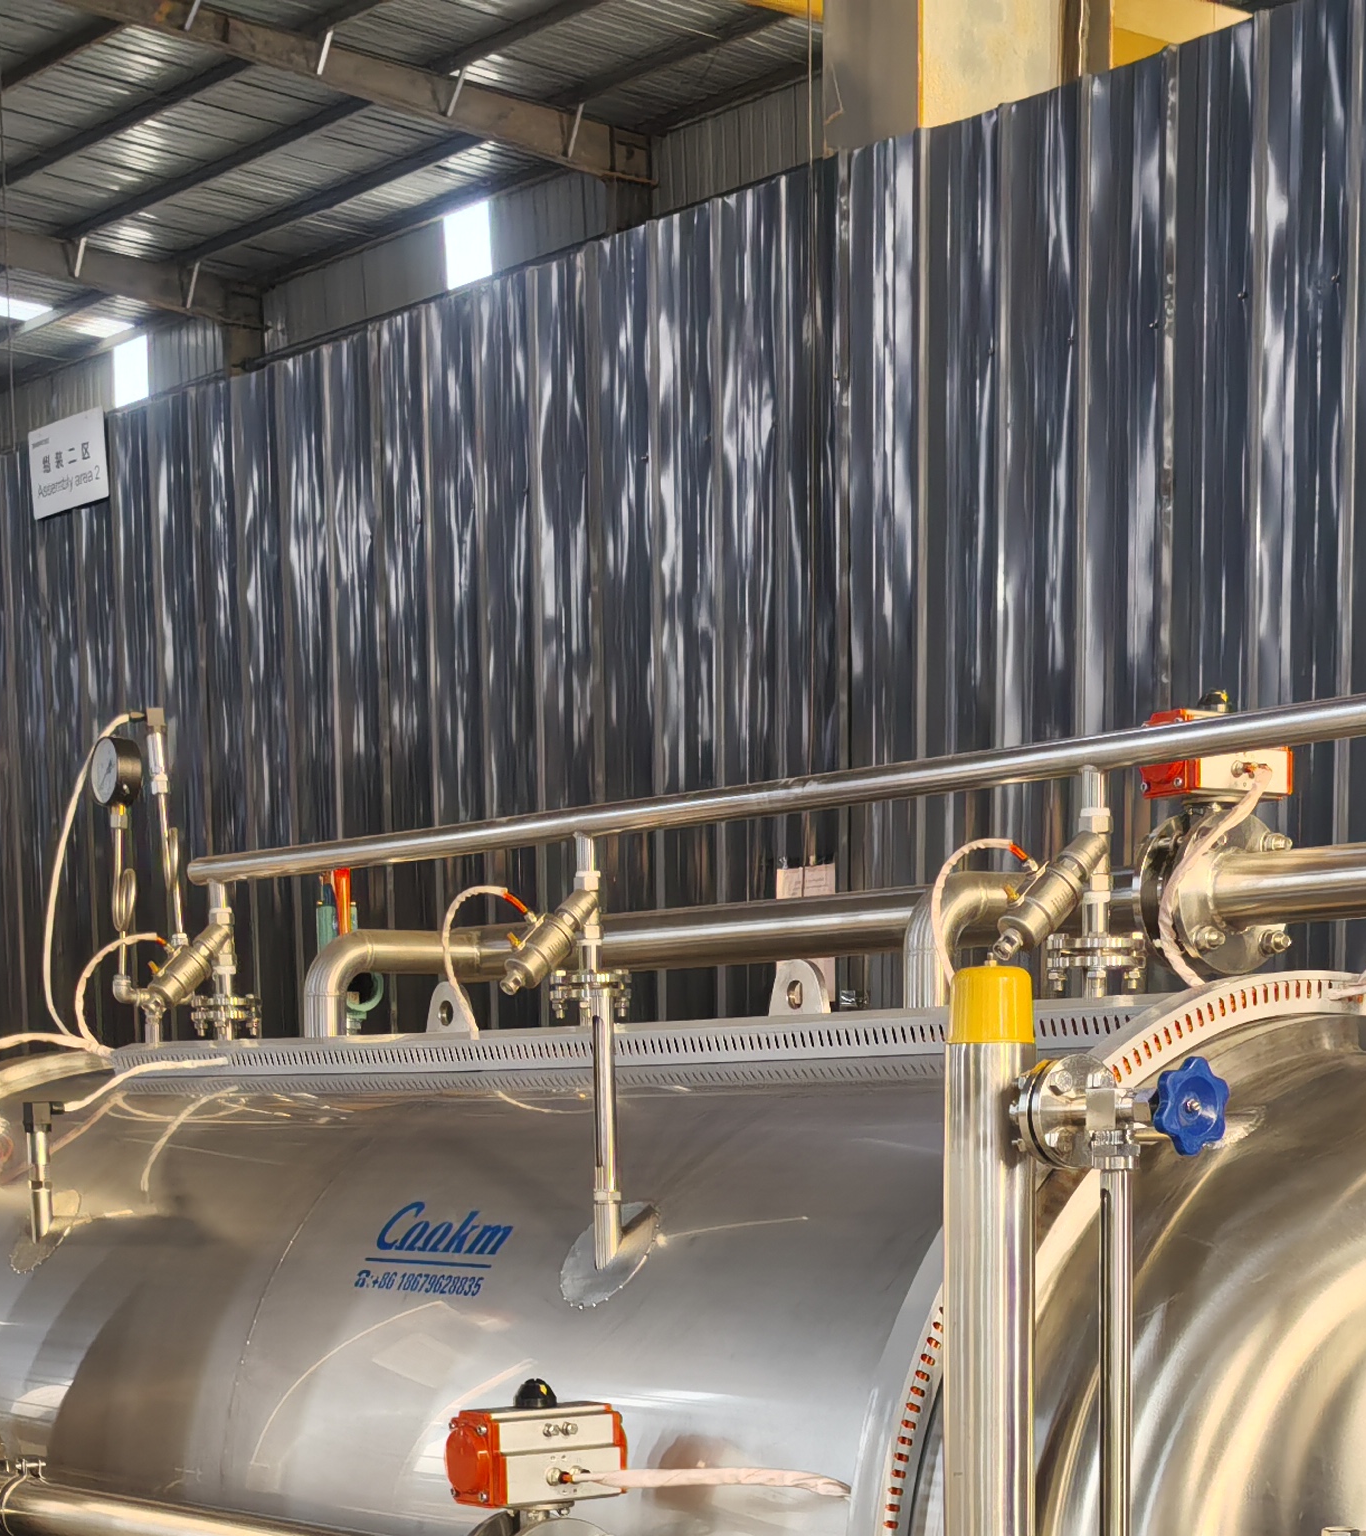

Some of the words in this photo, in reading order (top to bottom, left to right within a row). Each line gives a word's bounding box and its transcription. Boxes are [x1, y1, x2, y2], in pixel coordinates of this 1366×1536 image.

[37, 476, 74, 498] Assembly
[75, 470, 94, 487] area
[94, 465, 101, 481] 2
